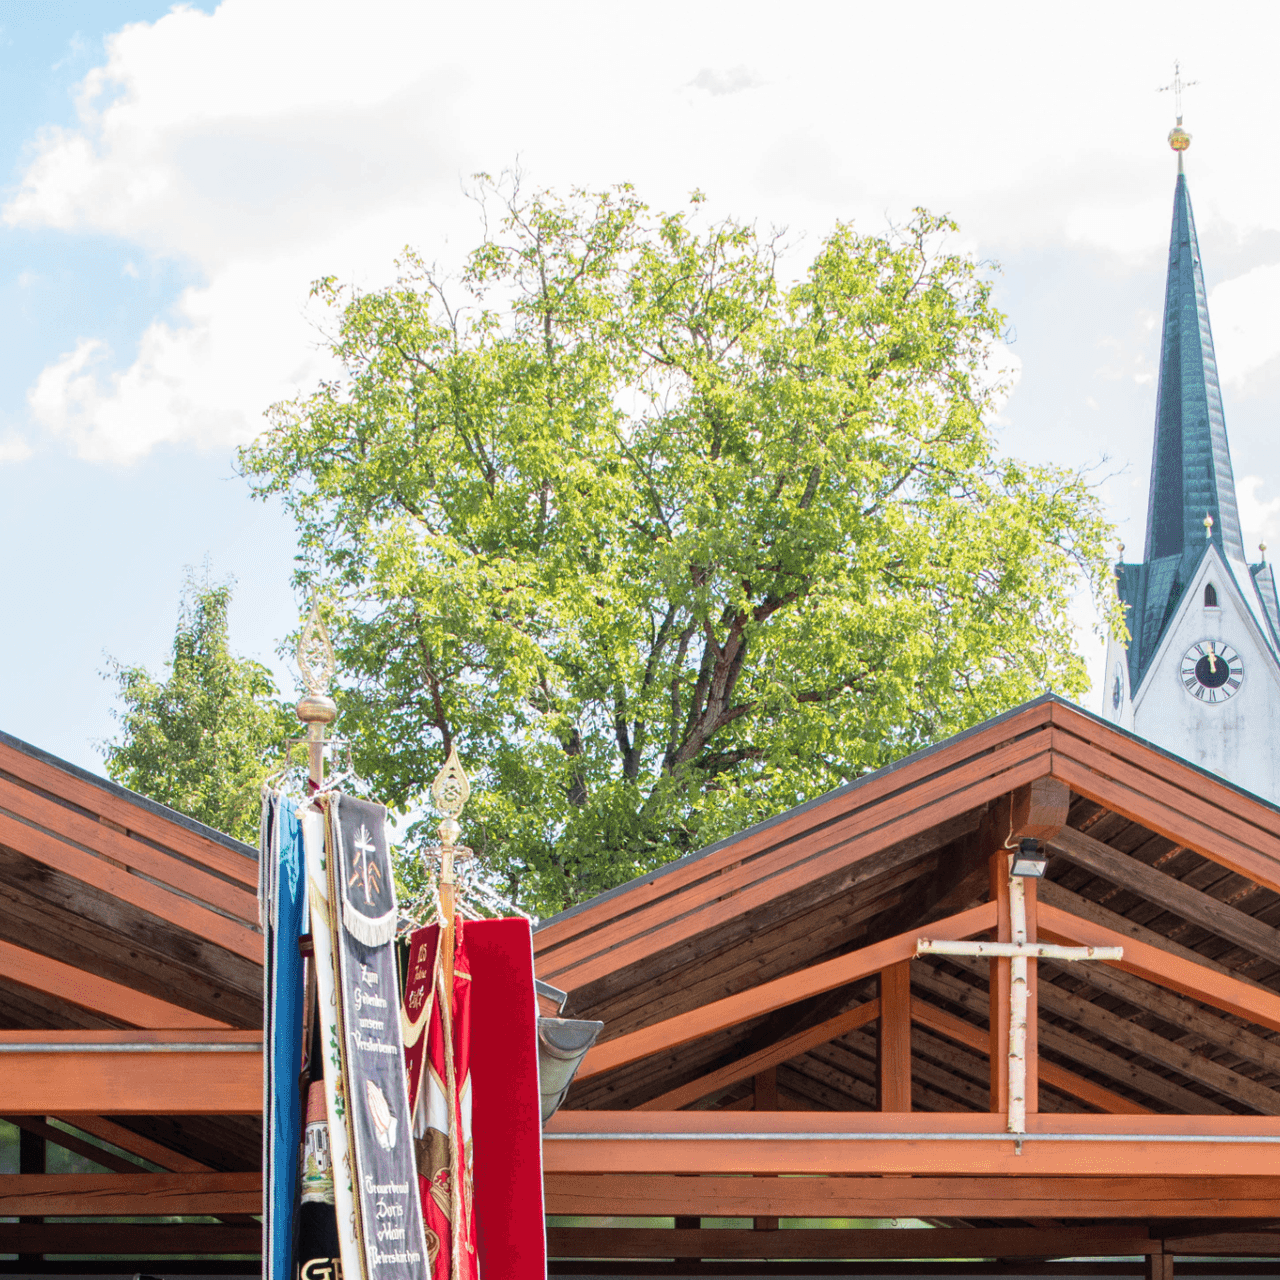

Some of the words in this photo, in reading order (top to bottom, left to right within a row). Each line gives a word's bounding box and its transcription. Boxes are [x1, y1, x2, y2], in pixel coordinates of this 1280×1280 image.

[360, 963, 379, 988] Zum
[354, 988, 388, 1011] Gedenken
[359, 1017, 384, 1031] unserer
[351, 1030, 398, 1055] Verstorbenen
[375, 1197, 404, 1220] Doris
[368, 1245, 421, 1269] Peterskirchen
